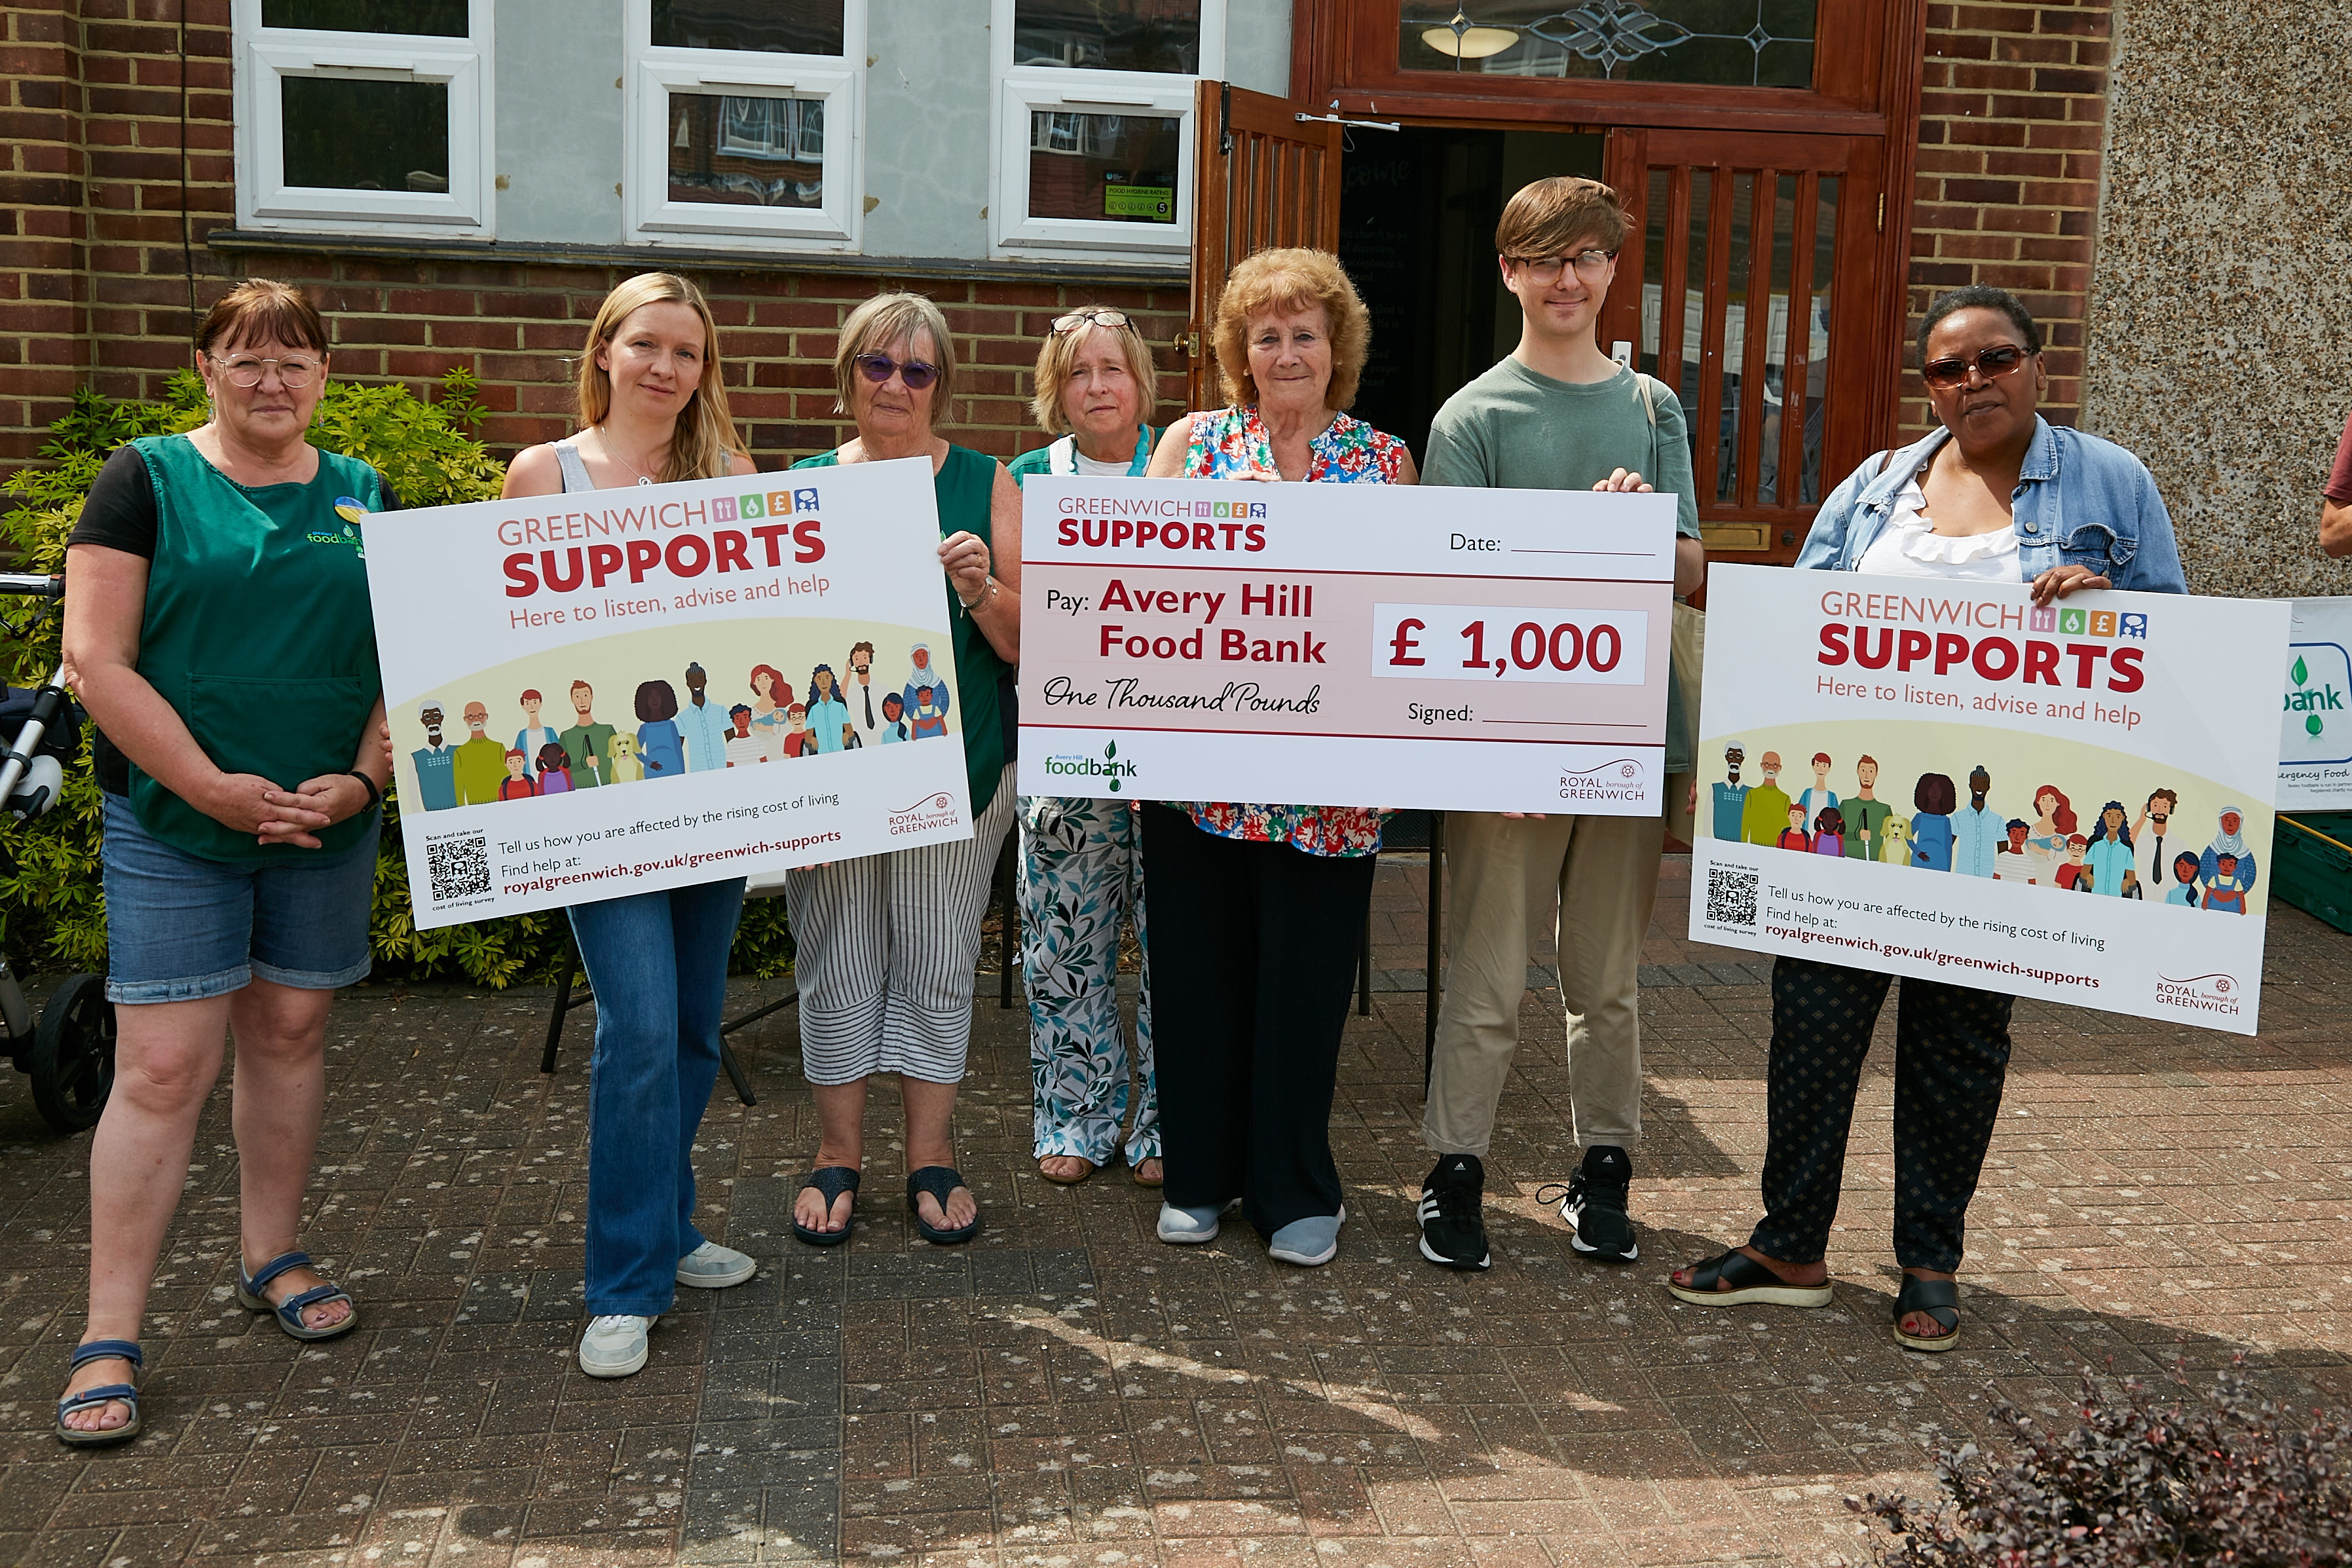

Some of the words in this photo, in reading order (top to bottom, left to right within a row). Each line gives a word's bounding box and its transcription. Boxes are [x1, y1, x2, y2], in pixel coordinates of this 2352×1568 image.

[1343, 160, 1412, 195] come
[1159, 203, 1166, 212] 5
[1058, 497, 1190, 517] GREENWICH
[497, 500, 707, 546] GREENWICH
[1058, 518, 1265, 551] SUPPORTS
[307, 533, 362, 545] foodban
[1450, 533, 1501, 551] Date:
[502, 520, 825, 597] SUPPORTS
[510, 608, 565, 629] Here
[572, 607, 596, 621] to
[604, 599, 666, 617] listen,
[674, 587, 736, 608] advise
[744, 578, 779, 600] and
[787, 573, 829, 597] help
[1047, 589, 1089, 616] Pay:
[1098, 579, 1225, 624] Avery
[1241, 583, 1312, 617] Hill
[1821, 591, 2023, 630] GREENWICH
[1100, 625, 1203, 660] Food
[1220, 628, 1326, 663] Bank
[1389, 618, 1426, 666] £
[1460, 620, 1621, 678] 1,000
[1818, 623, 2144, 693] SUPPORTS
[1043, 676, 1097, 705] One
[1106, 678, 1234, 711] Thousand
[1231, 682, 1320, 714] Pounds
[1817, 675, 1866, 698] Here
[1875, 685, 1895, 700] to
[1905, 684, 1964, 710] listen,
[1973, 692, 2037, 715] advise
[2046, 700, 2085, 720] and
[2094, 701, 2140, 731] help
[1408, 703, 1473, 725] Signed:
[1045, 756, 1137, 777] foodbank
[2324, 768, 2350, 778] Food
[1559, 788, 1644, 800] GREENWICH
[1560, 777, 1602, 787] ROYAL
[497, 840, 521, 854] Tell
[525, 841, 540, 850] us
[544, 836, 572, 848] how
[576, 831, 600, 846] you
[605, 828, 625, 838] are
[629, 815, 679, 834] affected
[683, 814, 698, 828] by
[702, 811, 722, 823] the
[726, 806, 759, 819] rising
[762, 801, 788, 813] cost
[791, 796, 804, 808] of
[808, 794, 839, 806] living
[889, 813, 924, 825] ROYAL
[890, 816, 958, 835] GREENWICH
[925, 810, 948, 819] borough
[501, 861, 529, 877] Find
[532, 858, 561, 872] help
[565, 857, 580, 867] at:
[504, 831, 841, 895] royalgreenwich.gov.uk/greenwich-supports
[1766, 906, 1790, 920] Find
[1794, 910, 1819, 927] help
[1823, 918, 1837, 928] at:
[1768, 885, 1787, 899] Tell
[1791, 892, 1803, 901] us
[1808, 891, 1834, 905] how
[1837, 899, 1859, 910] you
[1863, 903, 1882, 914] are
[1886, 905, 1935, 922] affected
[1940, 911, 1954, 927] by
[1958, 915, 1979, 928] the
[1983, 920, 2017, 938] rising
[2021, 927, 2047, 939] cost
[2052, 930, 2067, 942] of
[2071, 931, 2104, 952] living
[1766, 925, 2099, 988] royalgreenwich.gov.uk/greenwich-supports
[2157, 982, 2197, 998] ROYAL
[2201, 992, 2228, 1002] borough
[2156, 994, 2238, 1015] GREENWICH
